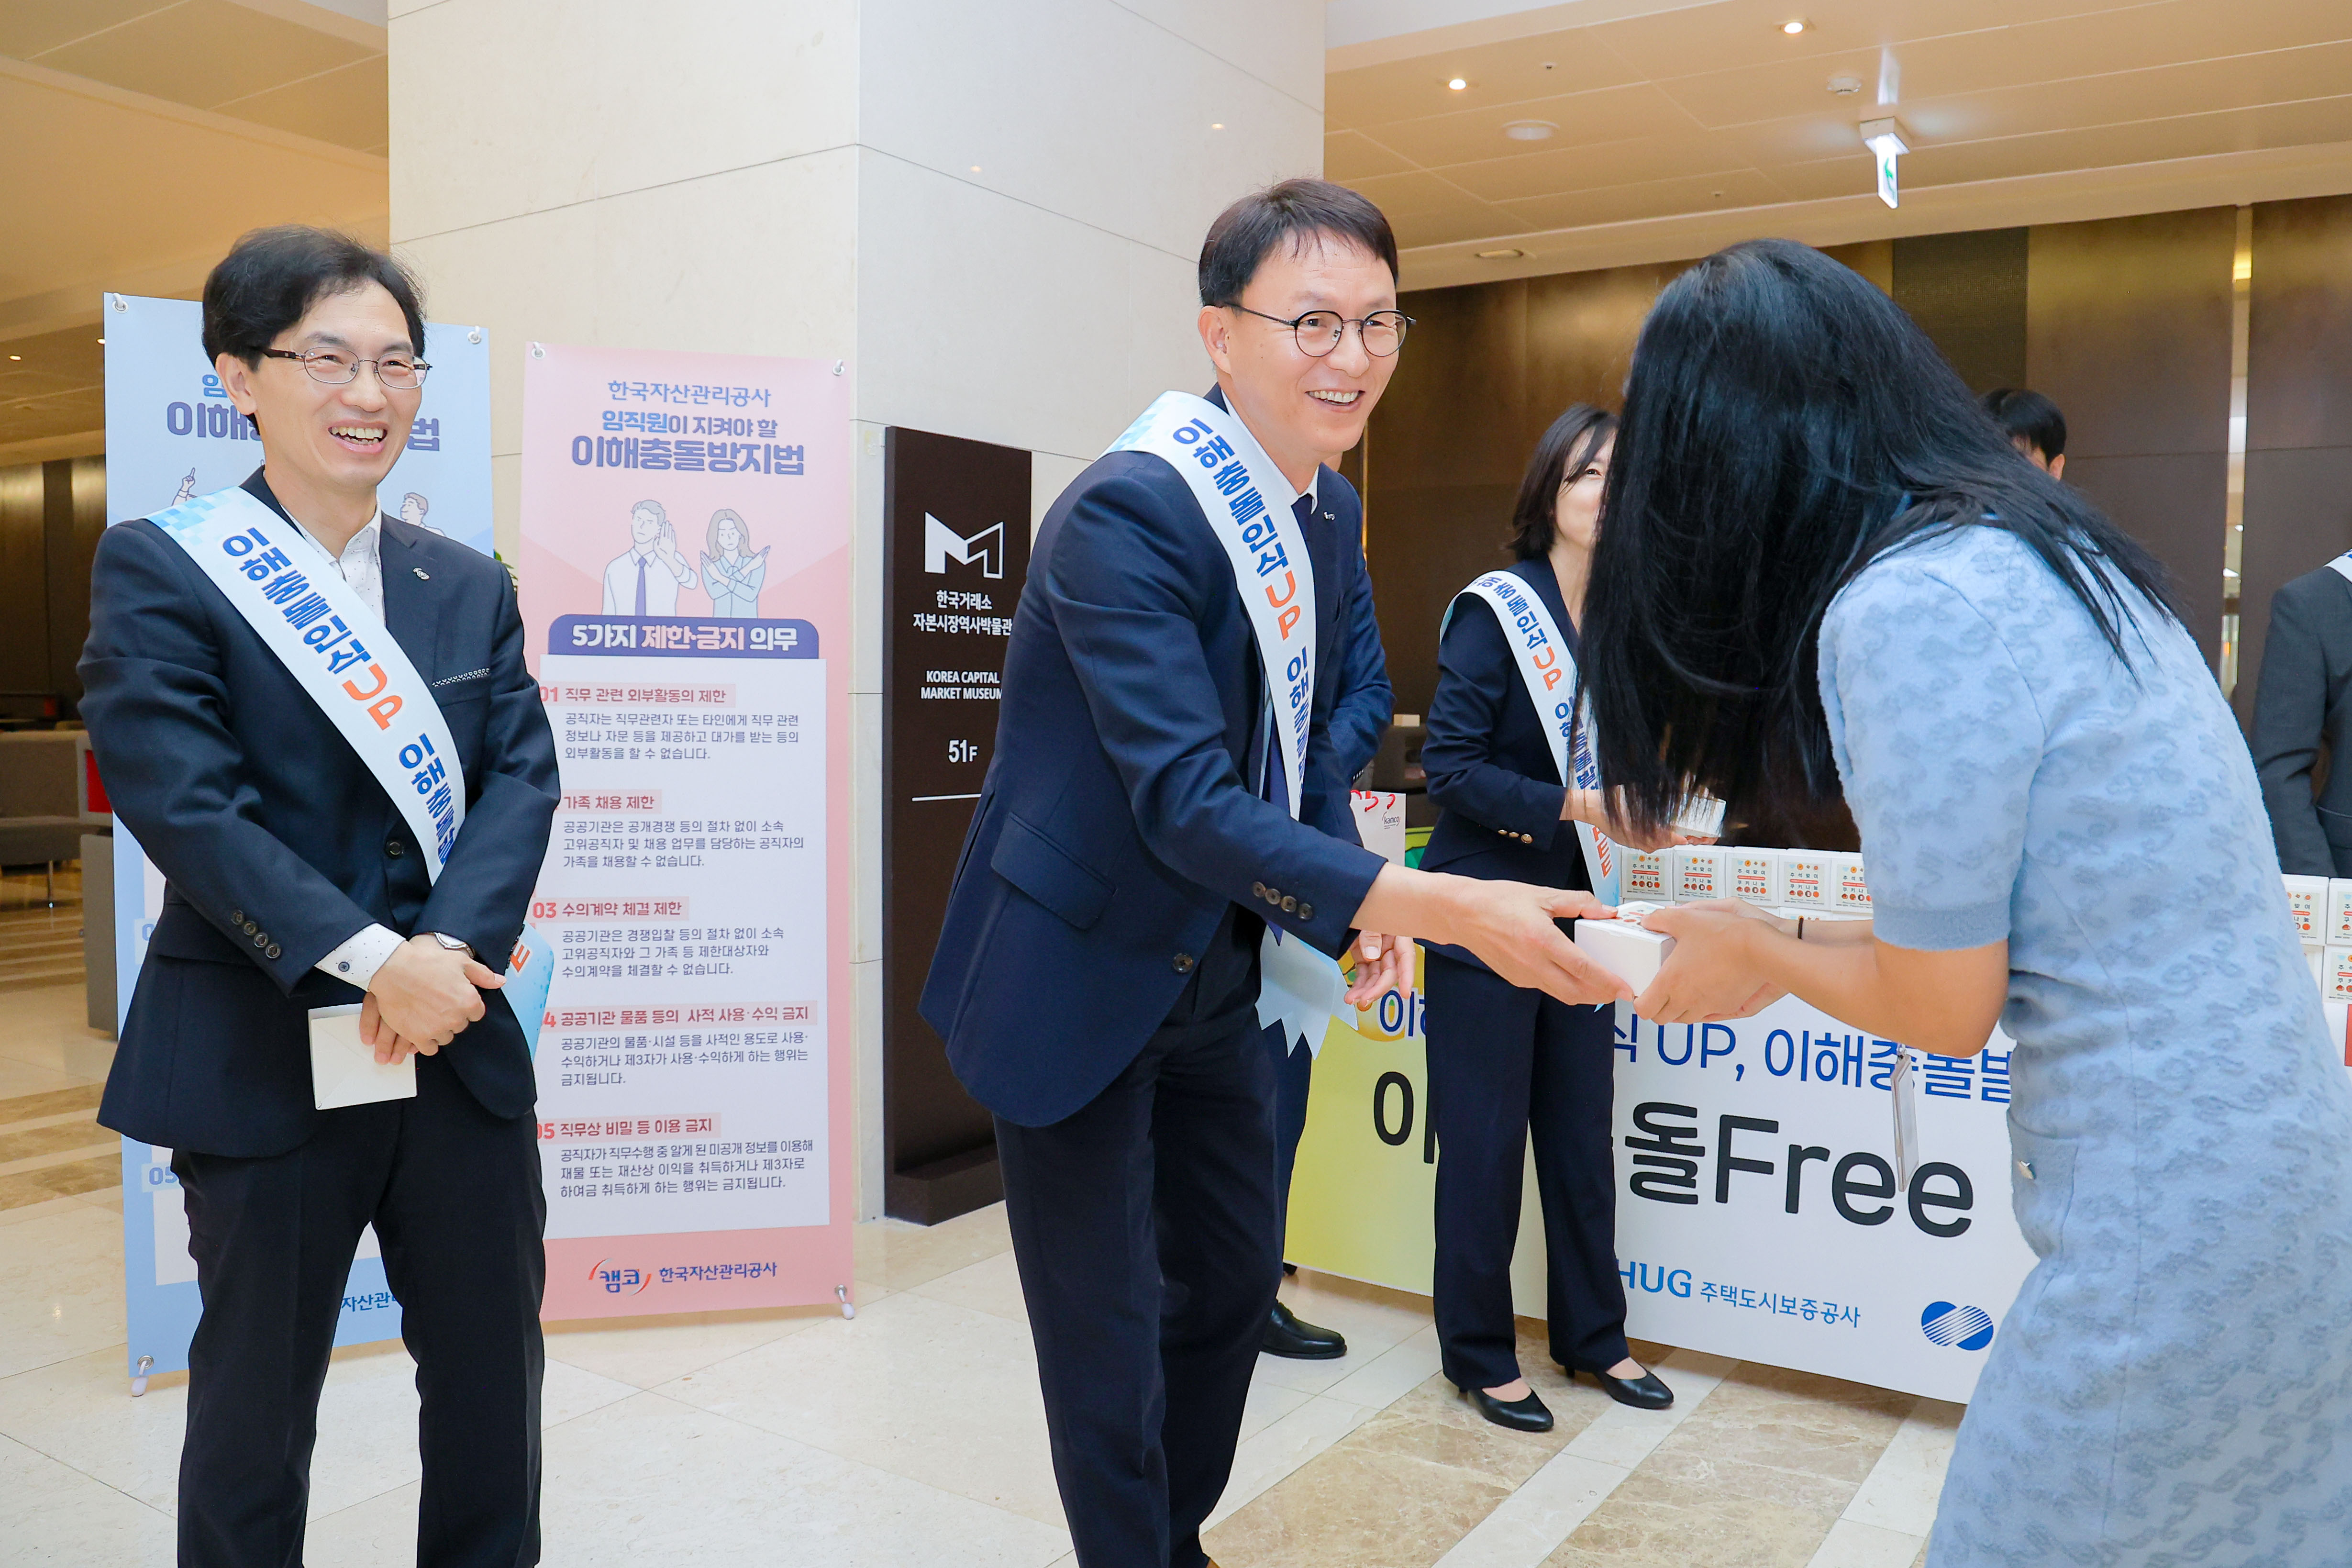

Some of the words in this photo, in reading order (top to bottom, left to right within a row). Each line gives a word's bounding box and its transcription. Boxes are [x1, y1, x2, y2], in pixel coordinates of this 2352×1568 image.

[608, 380, 771, 407] 한국자산관리공사
[602, 411, 687, 434] 임직원이
[693, 417, 753, 437] 지켜야
[757, 419, 777, 438] 할
[572, 436, 804, 475] 이해충돌방지법
[936, 590, 992, 611] 한국거래소
[913, 613, 1014, 635] 자본시장역사박물관
[572, 624, 637, 648] 5가지
[750, 628, 798, 651] 의무
[927, 671, 960, 683] KOREA
[962, 672, 1000, 683] CAPITAL
[566, 689, 591, 701] 직무
[596, 689, 623, 701] 관련
[628, 689, 693, 702] 외부활동의
[699, 689, 726, 702] 제한
[921, 687, 961, 699] MARKET
[566, 713, 611, 725] 공직자는
[616, 714, 673, 725] 직무관련자
[677, 714, 699, 725] 또는
[703, 714, 746, 726] 타인에게
[752, 715, 773, 726] 직무
[777, 715, 798, 726] 관련
[566, 730, 601, 742] 정보나
[606, 731, 628, 742] 자문
[633, 731, 655, 742] 등을
[661, 731, 706, 743] 제공하고
[712, 732, 745, 743] 대가를
[750, 732, 772, 743] 받는
[777, 732, 798, 743] 등의
[566, 747, 624, 759] 외부활동을
[629, 748, 640, 759] 할
[645, 748, 655, 759] 수
[661, 748, 710, 759] 없습니다.
[949, 740, 977, 762] 51F
[564, 796, 590, 809] 가족
[596, 796, 621, 809] 채용
[627, 796, 654, 809] 제한
[564, 822, 623, 833] 공공기관은
[628, 821, 675, 833] 공개경쟁
[680, 821, 701, 833] 등의
[708, 821, 730, 832] 절차
[734, 821, 756, 832] 없이
[762, 821, 783, 832] 소속
[1384, 816, 1399, 824] kamco
[564, 839, 624, 850] 고위공직자
[628, 839, 638, 850] 및
[644, 838, 666, 850] 채용
[672, 838, 705, 850] 업무를
[711, 838, 755, 849] 담당하는
[760, 837, 803, 849] 공직자의
[564, 856, 598, 867] 가족을
[602, 856, 637, 867] 채용할
[641, 856, 651, 867] 수
[656, 856, 704, 867] 없습니다.
[533, 902, 556, 918] 03
[563, 903, 618, 916] 수의계약
[623, 902, 649, 915] 체결
[654, 901, 682, 915] 제한
[563, 930, 622, 943] 공공기관은
[628, 929, 675, 941] 경쟁입찰
[679, 929, 701, 941] 등의
[707, 928, 730, 940] 절차
[734, 928, 756, 939] 없이
[762, 928, 784, 939] 소속
[562, 947, 635, 960] 고위공직자와
[639, 947, 650, 958] 그
[655, 946, 677, 958] 가족
[683, 946, 693, 958] 등
[699, 945, 769, 957] 제한대상자와
[563, 965, 622, 978] 수의계약을
[628, 964, 663, 976] 체결할
[667, 964, 677, 976] 수
[683, 963, 733, 975] 없습니다.
[542, 1012, 556, 1028] 4
[561, 1012, 616, 1026] 공공기관
[621, 1011, 647, 1024] 물품
[652, 1010, 678, 1023] 등의
[688, 1009, 714, 1022] 사적
[783, 1006, 808, 1020] 금지
[562, 1037, 620, 1050] 공공기관의
[679, 1035, 701, 1047] 등을
[706, 1034, 739, 1045] 사적인
[744, 1033, 777, 1045] 용도로
[562, 1055, 621, 1068] 수익하거나
[625, 1054, 667, 1066] 제3자가
[748, 1050, 770, 1062] 하는
[775, 1049, 808, 1061] 행위는
[561, 1073, 625, 1086] 금지됩니다.
[561, 1123, 601, 1137] 직무상
[606, 1121, 632, 1135] 비밀
[637, 1121, 650, 1134] 등
[655, 1120, 680, 1133] 이용
[686, 1118, 711, 1132] 금지
[561, 1148, 607, 1162] 공직자가
[610, 1146, 654, 1159] 직무수행
[657, 1145, 667, 1157] 중
[671, 1145, 692, 1157] 알게
[696, 1145, 706, 1156] 된
[710, 1143, 742, 1155] 미공개
[745, 1142, 777, 1154] 정보를
[781, 1140, 812, 1152] 이용해
[561, 1167, 584, 1179] 재물
[589, 1166, 612, 1178] 또는
[618, 1164, 654, 1177] 재산상
[659, 1163, 693, 1175] 이익을
[699, 1160, 758, 1173] 취득하거나
[763, 1158, 804, 1170] 제3자로
[561, 1185, 597, 1198] 하여금
[602, 1182, 649, 1196] 취득하게
[655, 1181, 677, 1193] 하는
[683, 1180, 718, 1192] 행위는
[723, 1176, 785, 1190] 금지됩니다.
[599, 1269, 639, 1293] 캠코
[659, 1262, 777, 1283] 한국자산관리공사
[342, 1291, 396, 1312] 자산관
[1700, 1281, 1861, 1328] 주택도시보증공사
